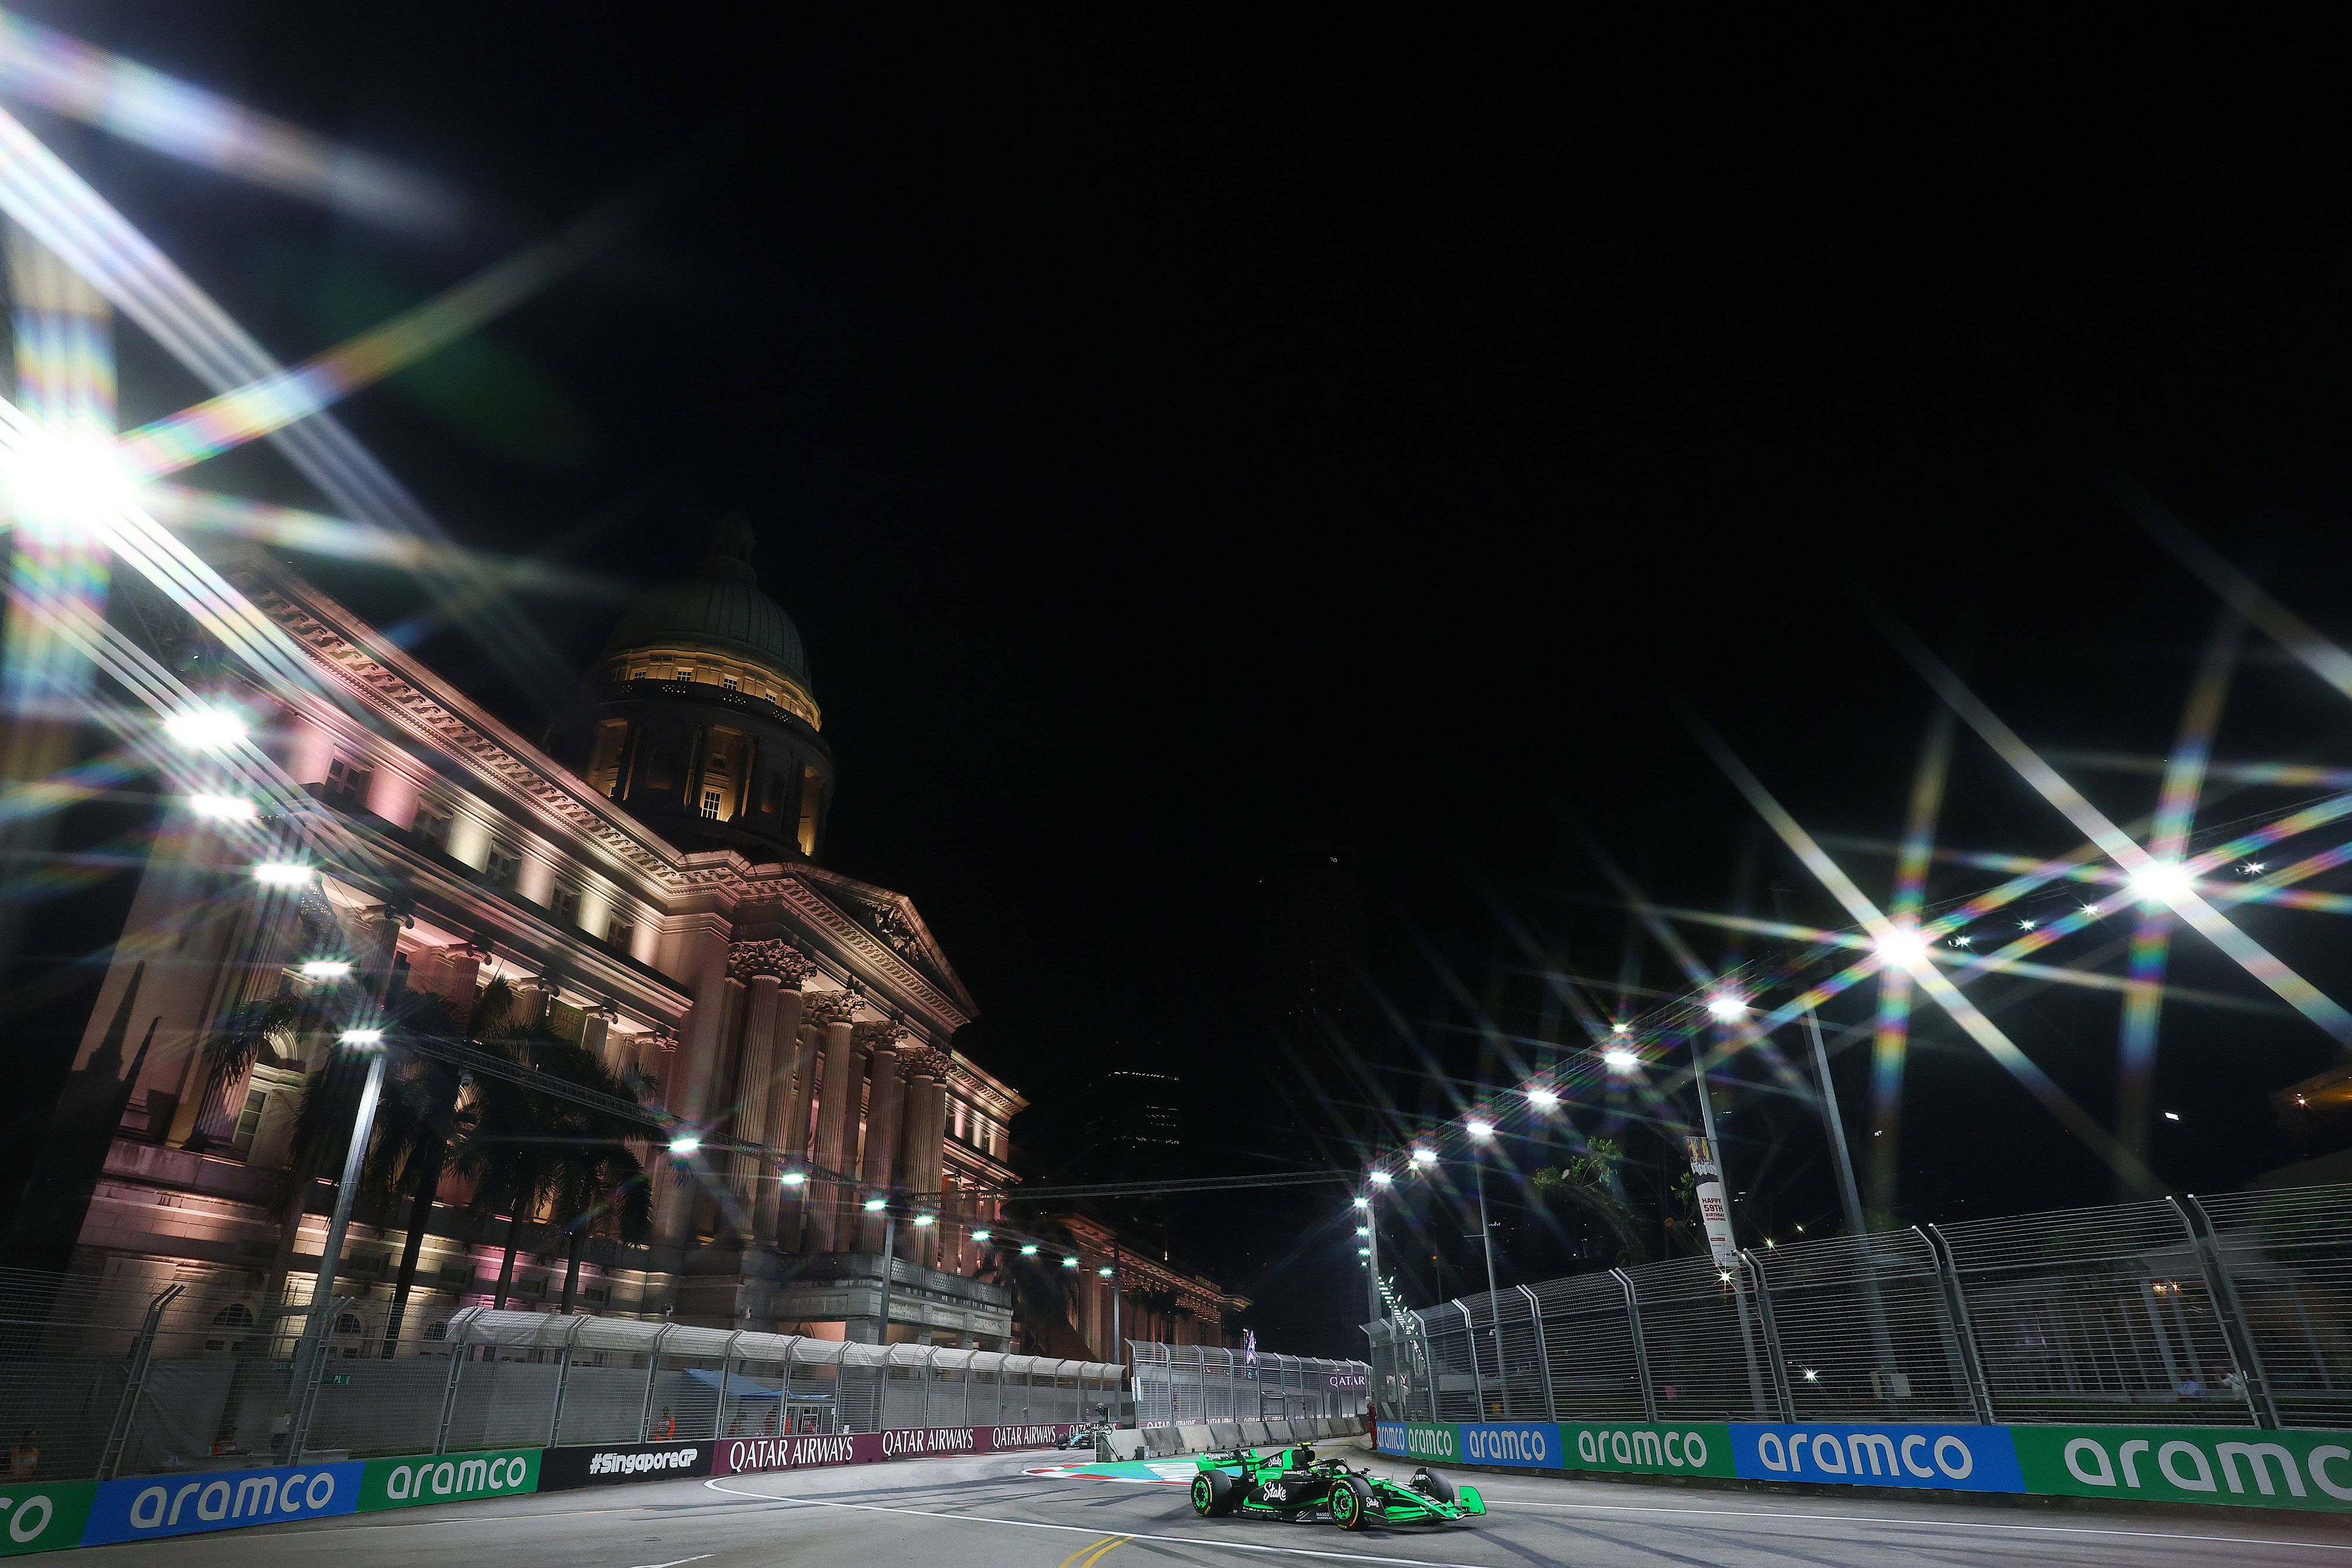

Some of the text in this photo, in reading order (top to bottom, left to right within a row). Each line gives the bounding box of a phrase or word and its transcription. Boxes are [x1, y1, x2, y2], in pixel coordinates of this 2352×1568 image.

[1703, 1204, 1723, 1212] 59TH
[1329, 1376, 1365, 1388] QATAR
[883, 1429, 973, 1456] QATAR AIRWAYS
[993, 1425, 1056, 1449] QATAR AIRWAYS
[1377, 1426, 1405, 1450] aramco
[1408, 1428, 1452, 1456] aramco
[1469, 1430, 1545, 1461] aramco
[1578, 1430, 1707, 1468] aramco
[589, 1448, 698, 1475] #SingaporeGP
[730, 1436, 854, 1473] QATAR AIRWAYS
[1268, 1455, 1282, 1467] Stake
[1758, 1433, 1973, 1479] aramco
[387, 1456, 526, 1499] aramco
[130, 1472, 335, 1529] aramco
[1263, 1482, 1287, 1501] Stake
[1365, 1496, 1379, 1508] Stake
